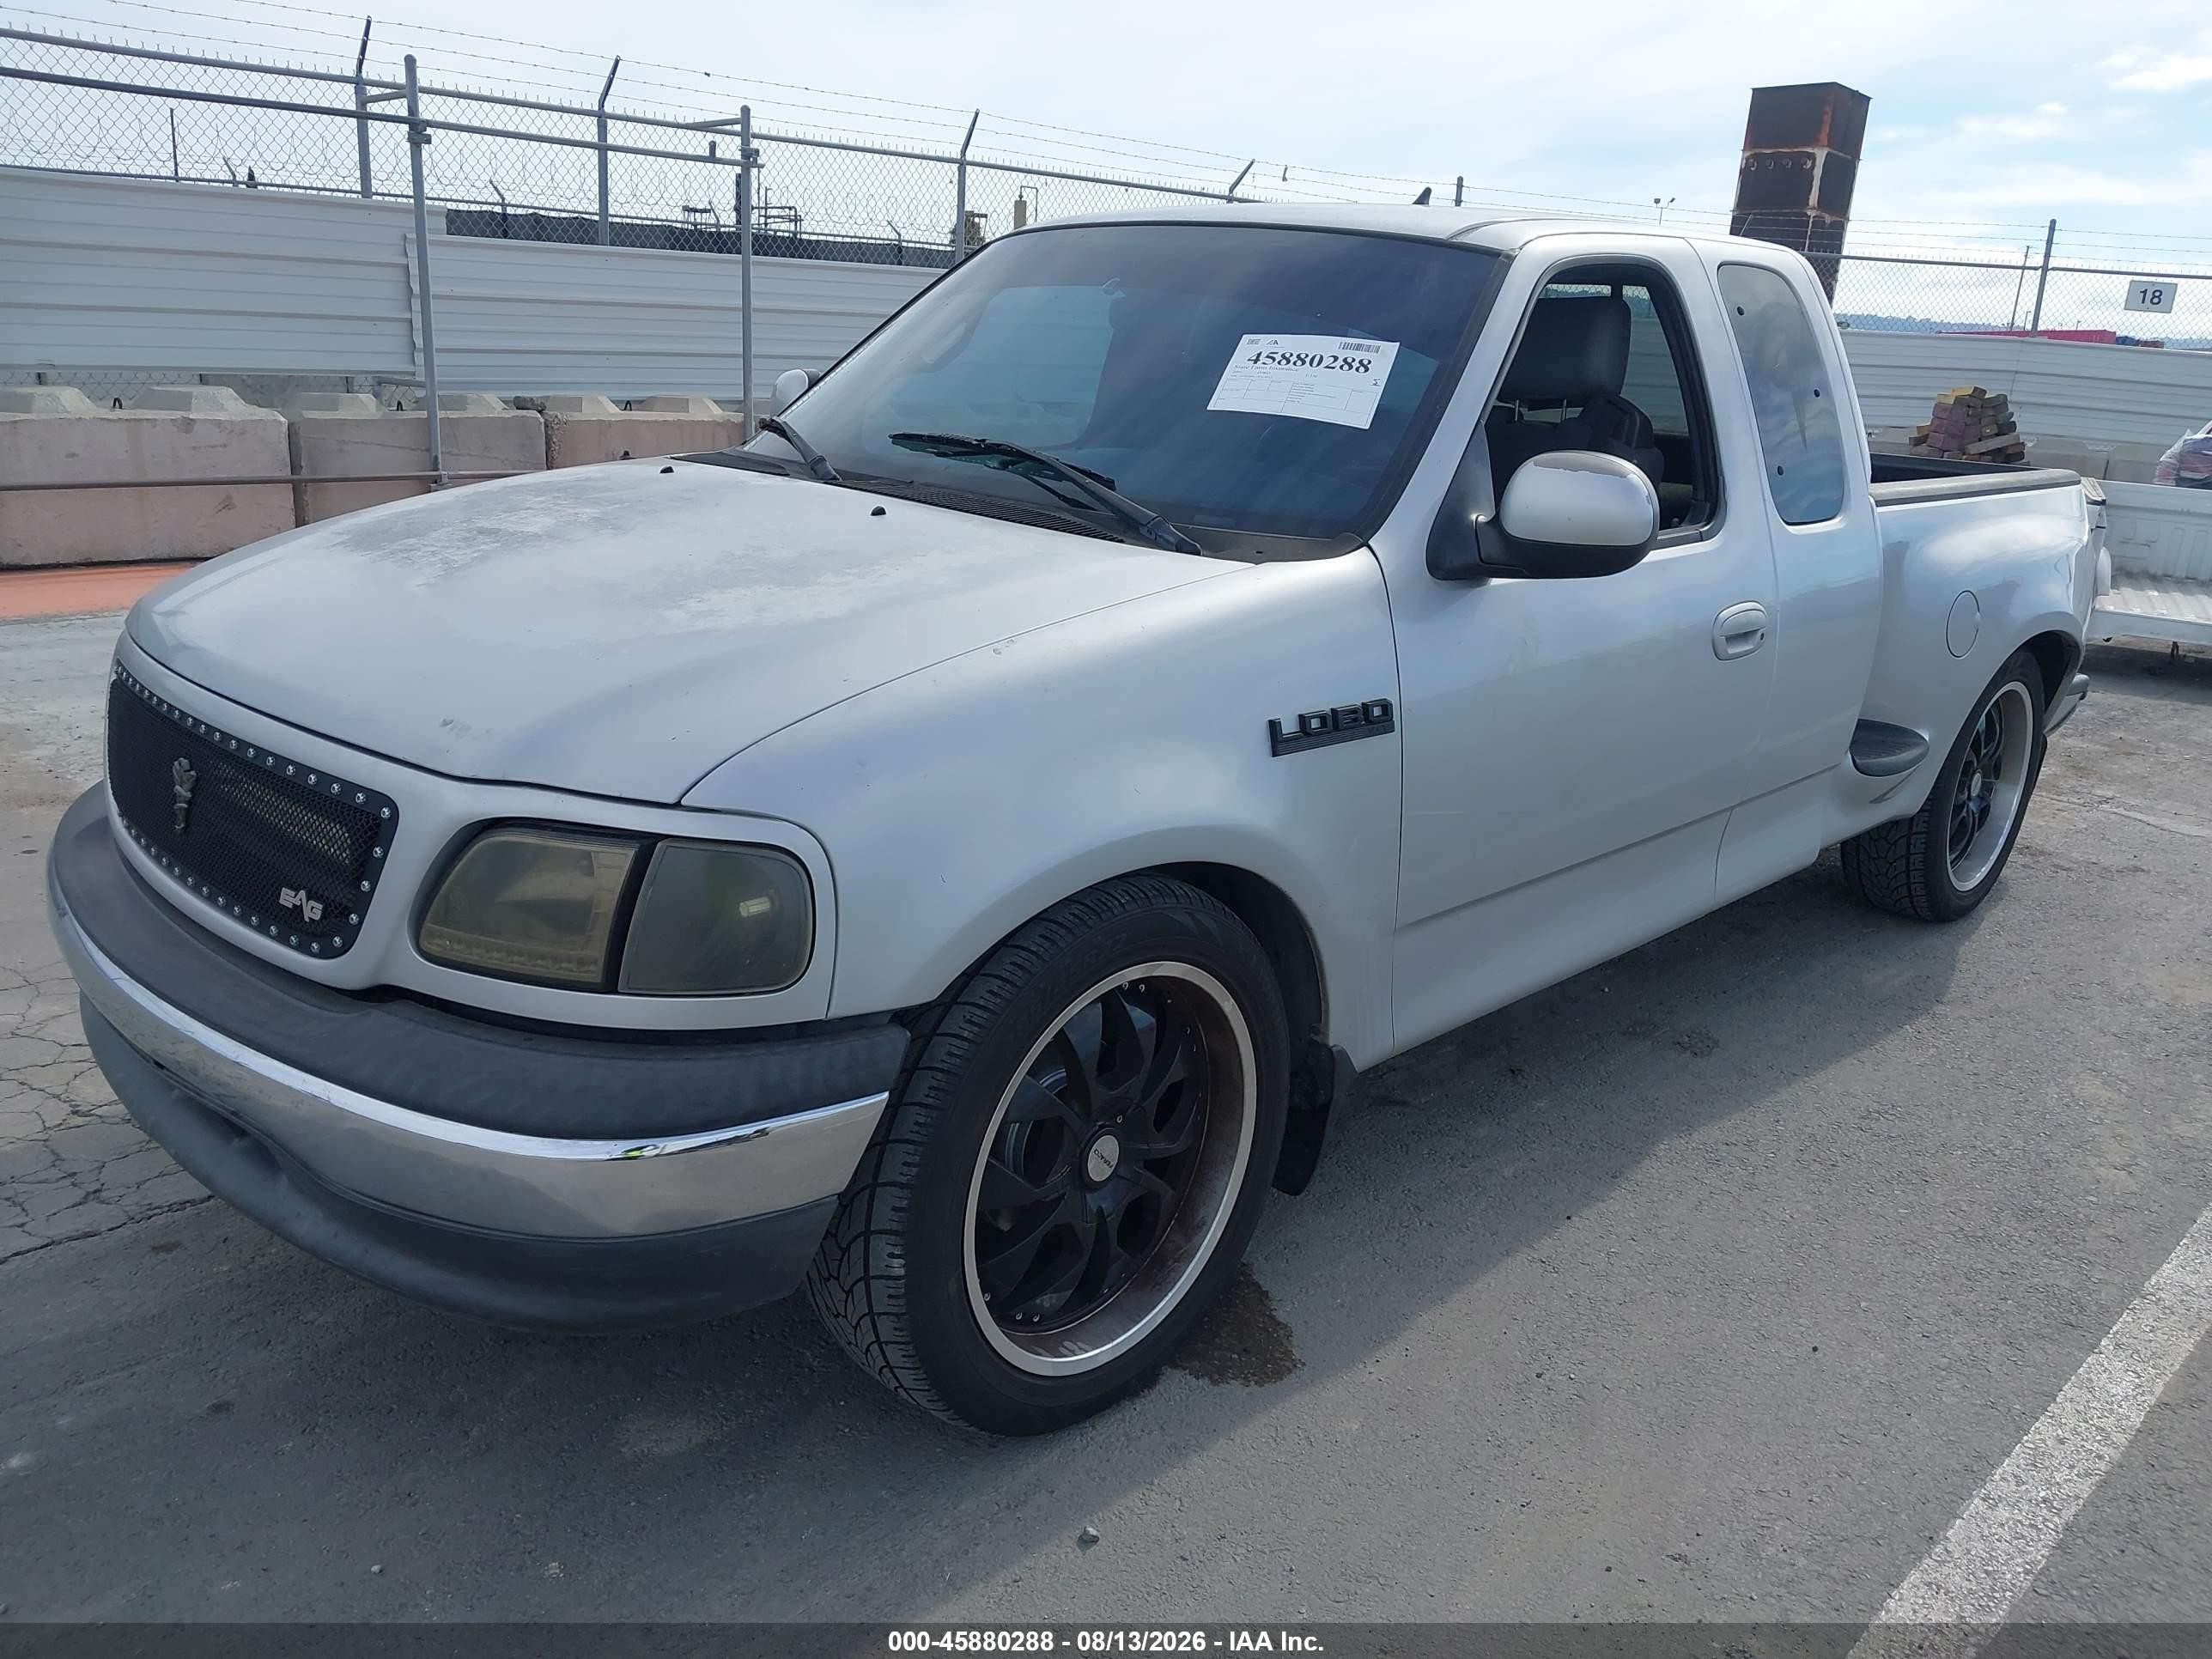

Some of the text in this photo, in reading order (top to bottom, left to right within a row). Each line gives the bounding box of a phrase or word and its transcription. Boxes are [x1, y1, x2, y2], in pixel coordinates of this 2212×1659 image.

[2139, 288, 2163, 306] 18
[1247, 350, 1372, 374] 45880288
[1267, 697, 1395, 744] LOBO
